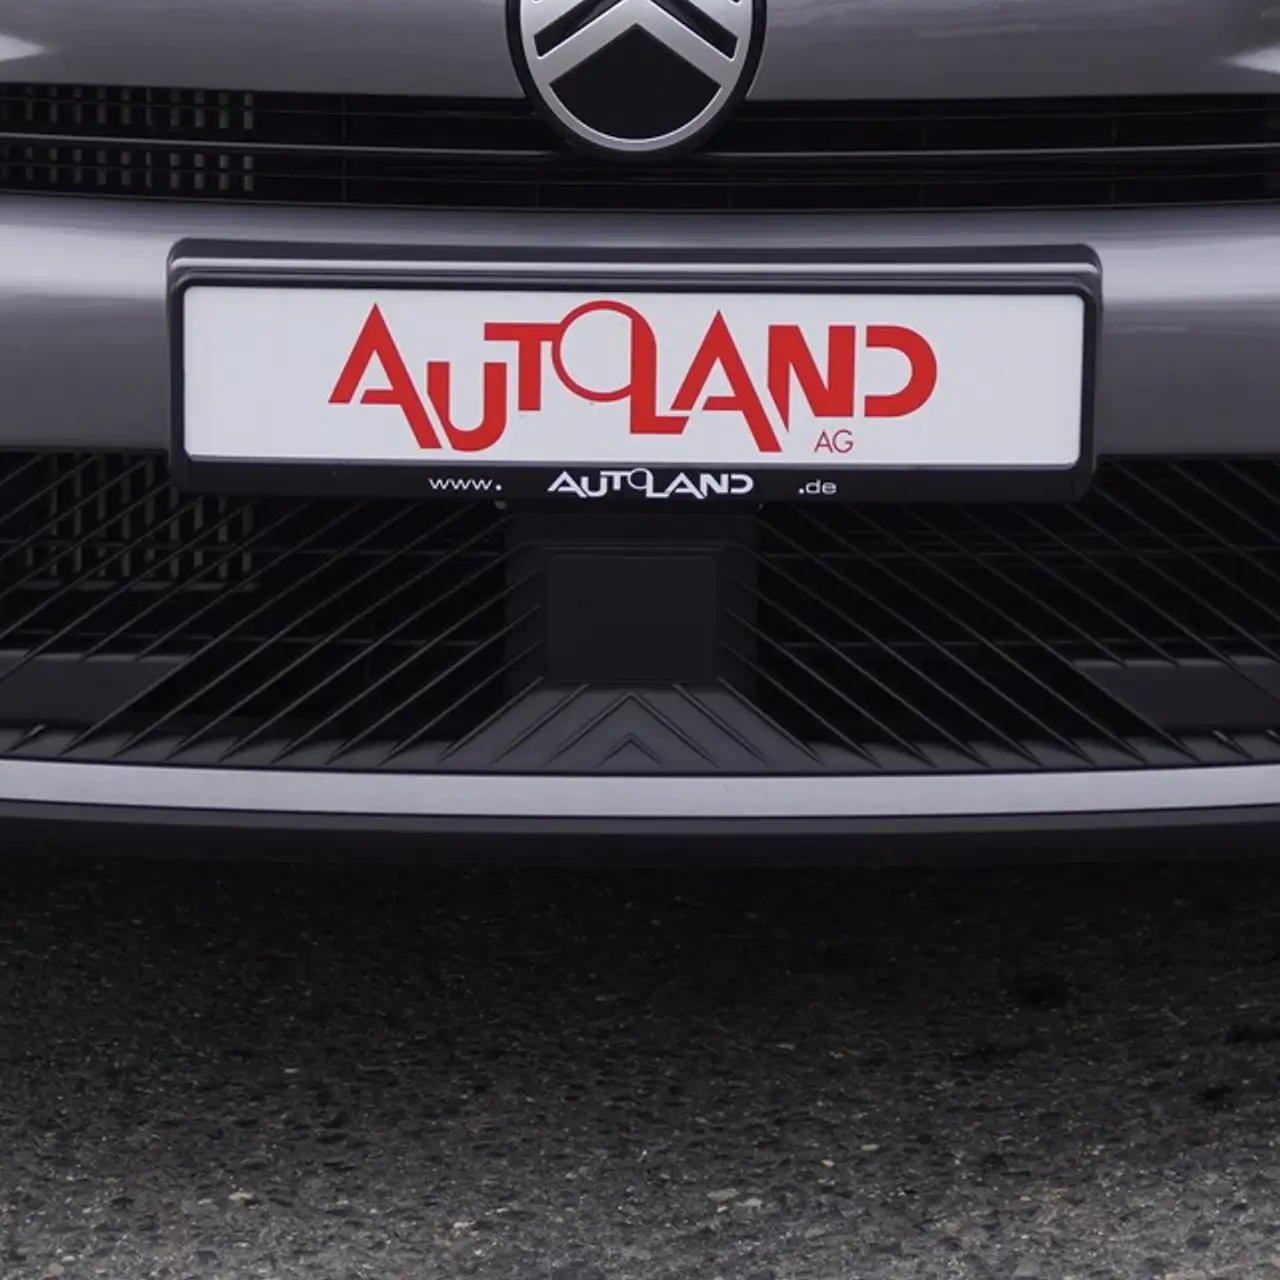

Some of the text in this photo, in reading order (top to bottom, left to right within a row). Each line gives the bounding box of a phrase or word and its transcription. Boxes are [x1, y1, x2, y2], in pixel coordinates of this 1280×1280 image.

[328, 298, 939, 455] AUTOLAND
[815, 428, 855, 455] AG
[428, 467, 838, 500] www. AUTOLAND .de
